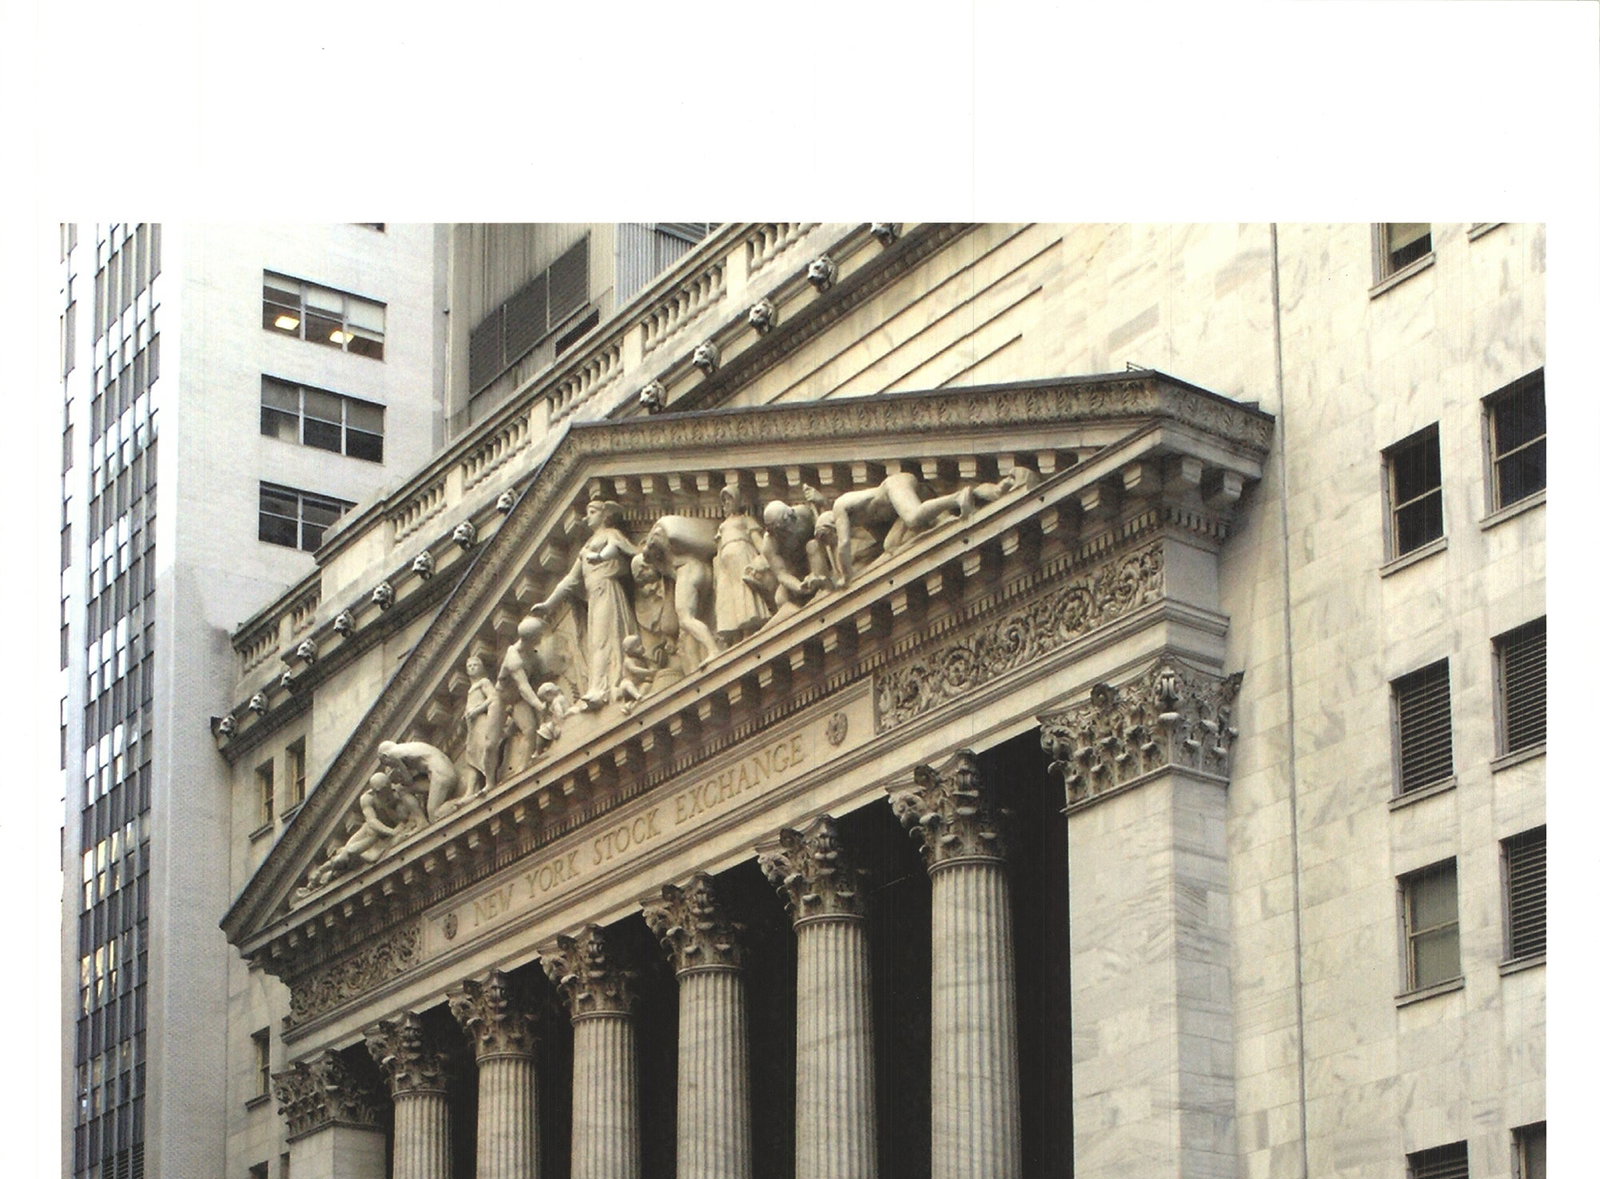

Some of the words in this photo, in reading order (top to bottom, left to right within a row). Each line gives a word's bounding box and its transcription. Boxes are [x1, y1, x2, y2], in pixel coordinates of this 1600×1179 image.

[473, 883, 515, 927] NEW
[525, 850, 581, 899] YORK
[592, 808, 662, 866] STOCK
[674, 733, 804, 826] EXCHANGE
